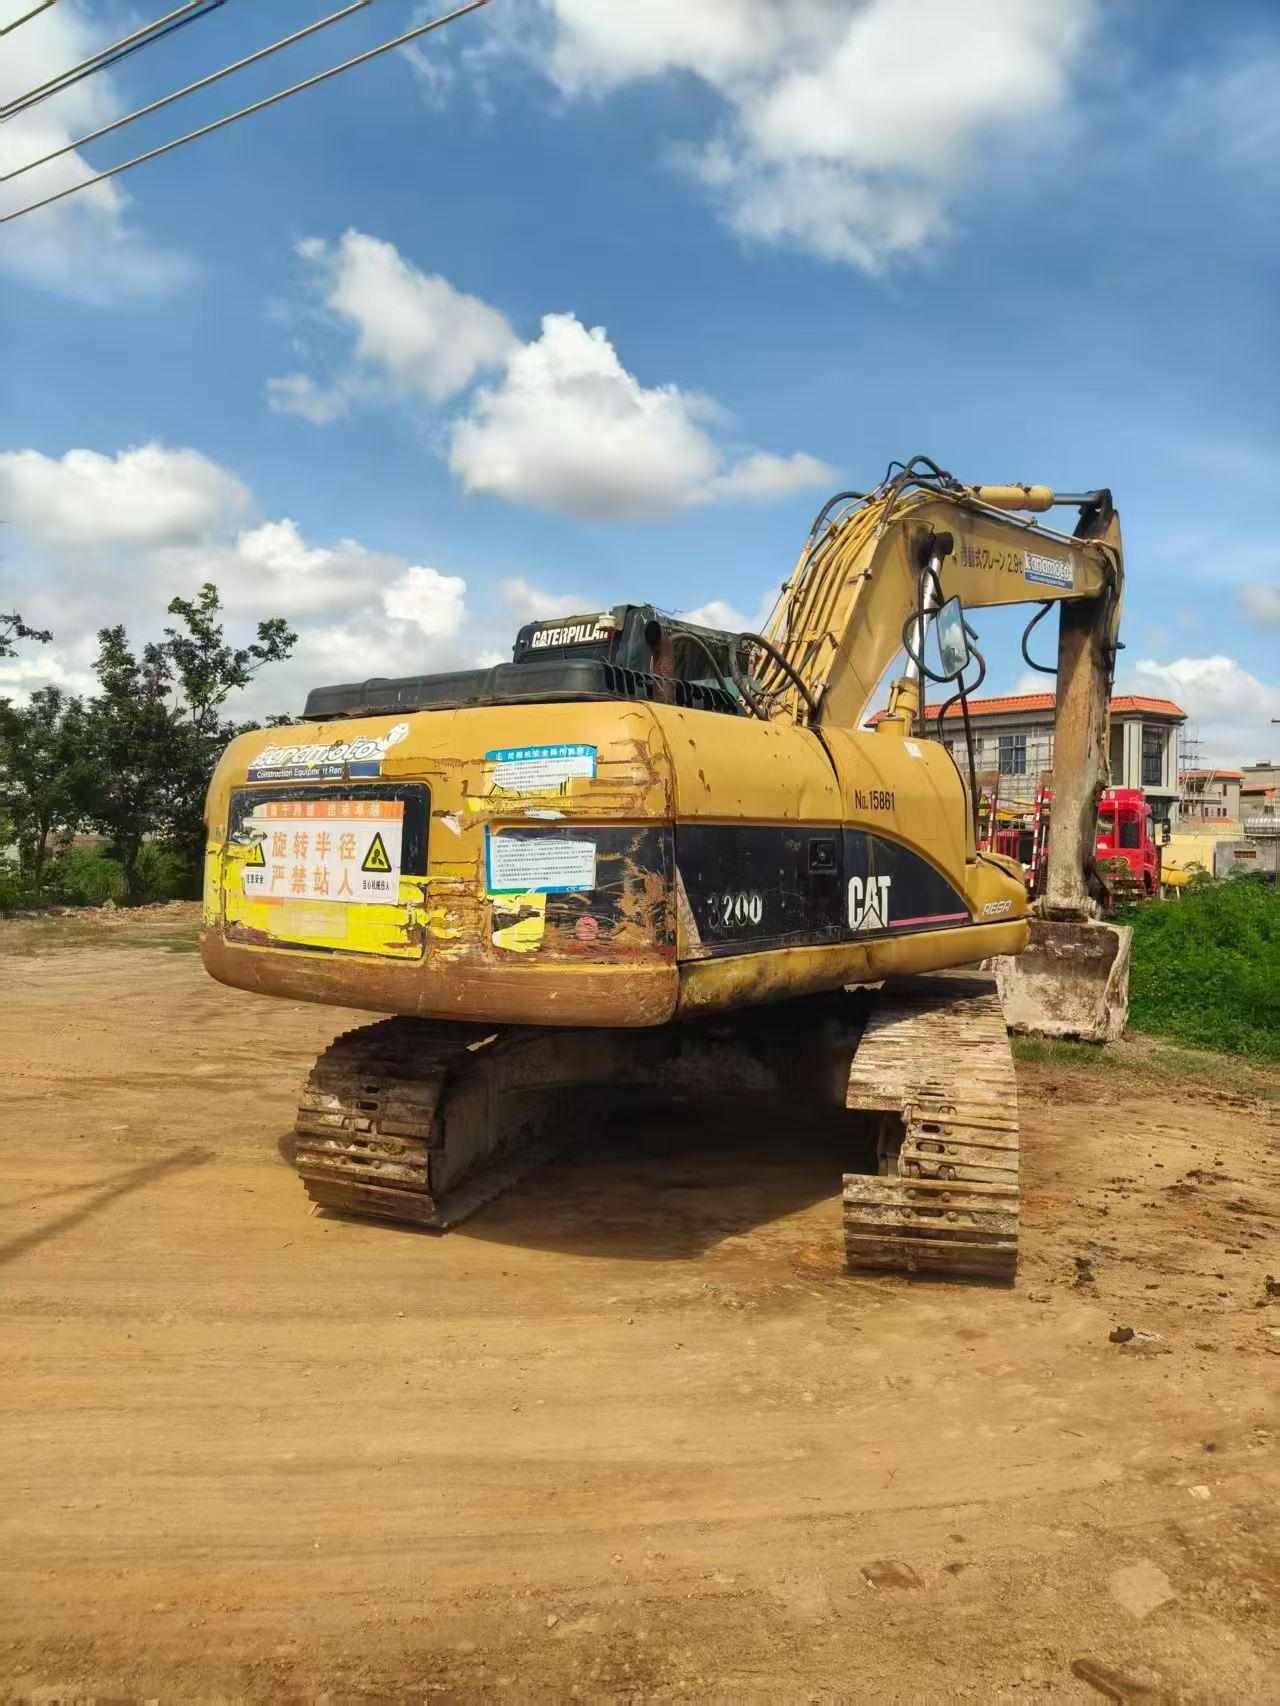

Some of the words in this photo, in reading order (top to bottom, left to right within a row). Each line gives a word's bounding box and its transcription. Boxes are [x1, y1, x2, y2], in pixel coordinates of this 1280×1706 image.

[257, 767, 293, 779] Construction
[855, 789, 895, 811] No.15861
[272, 831, 356, 860] 旋转半径
[270, 865, 353, 896] 严禁站人
[848, 876, 891, 930] CAT
